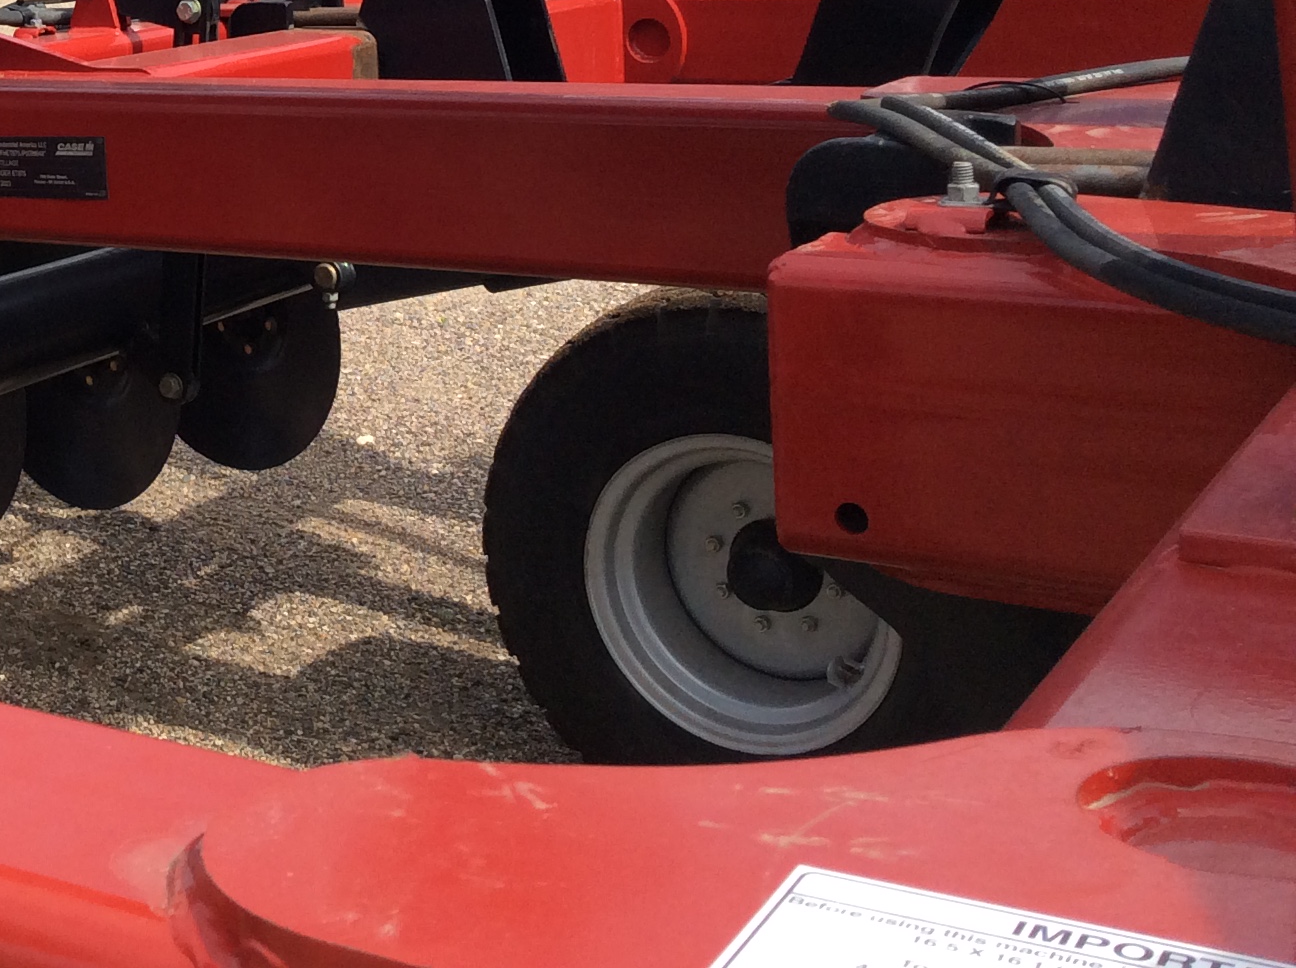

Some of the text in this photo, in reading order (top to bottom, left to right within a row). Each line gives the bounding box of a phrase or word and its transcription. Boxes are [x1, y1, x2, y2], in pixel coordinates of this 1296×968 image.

[788, 896, 1104, 968] Before using this machine
